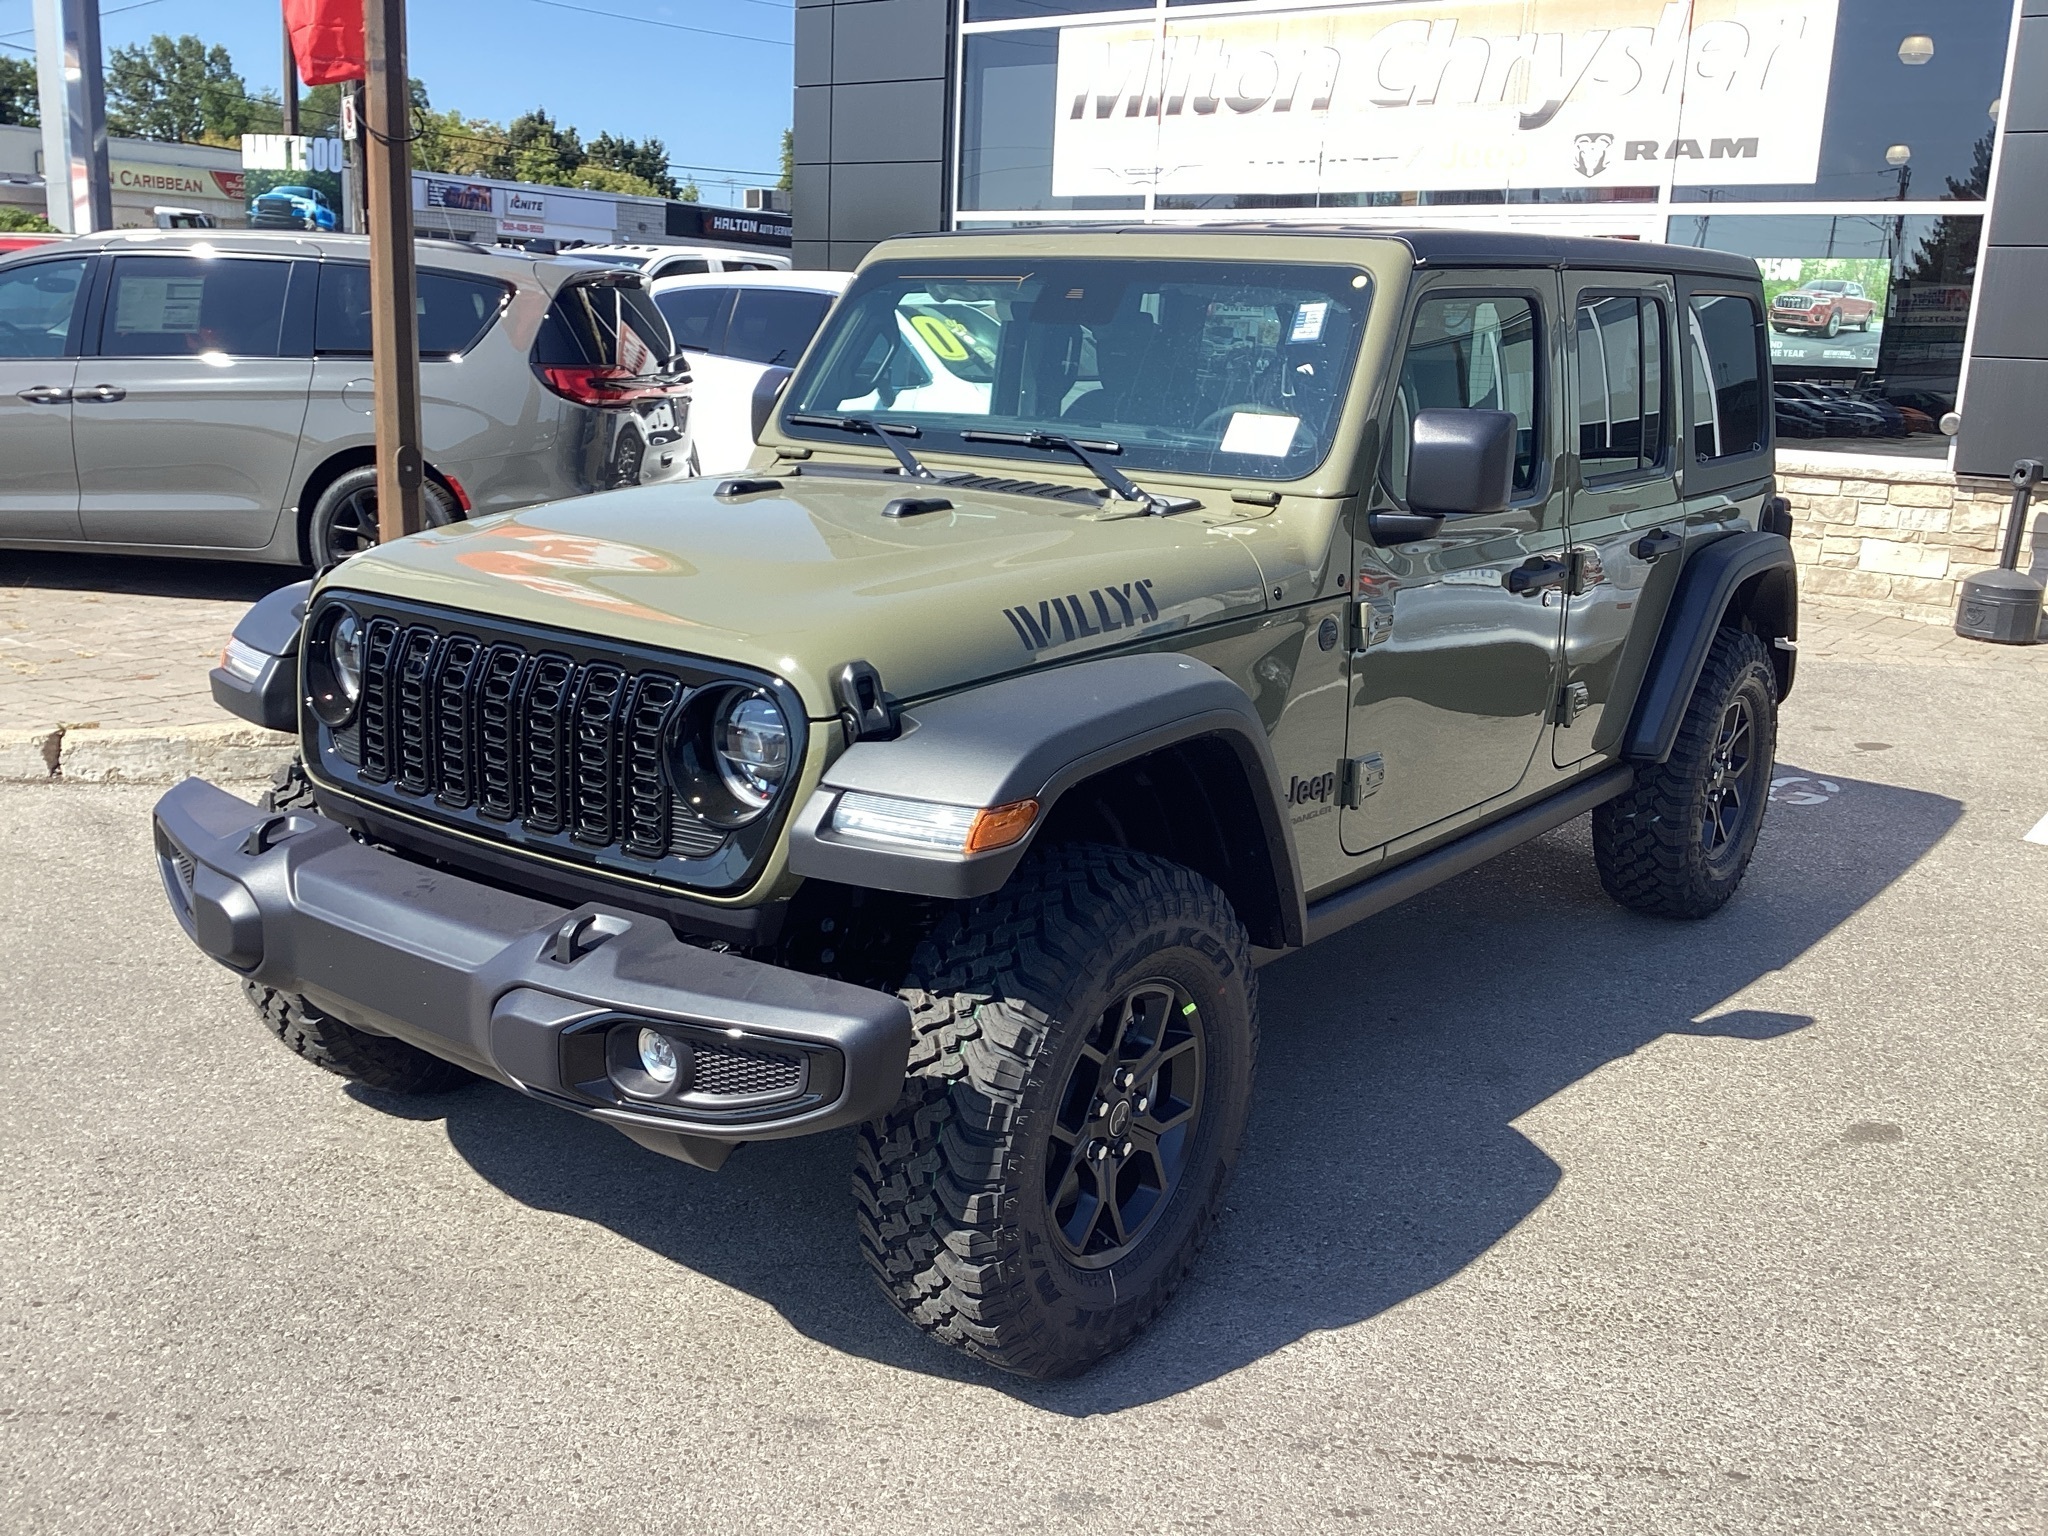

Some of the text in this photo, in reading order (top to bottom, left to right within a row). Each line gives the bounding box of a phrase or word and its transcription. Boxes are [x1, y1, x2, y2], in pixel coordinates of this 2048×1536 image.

[1069, 0, 1809, 132] Milton Chrysler
[289, 134, 343, 173] 1500
[1623, 136, 1760, 162] RAM
[120, 170, 203, 193] CARIBBEAN
[509, 198, 543, 211] IGNITE
[713, 216, 793, 236] HALTON AUTO SERVIC
[1770, 340, 1783, 349] ND
[1771, 349, 1782, 357] HE
[1002, 578, 1159, 651] WILLYS
[1284, 771, 1336, 809] Jeep
